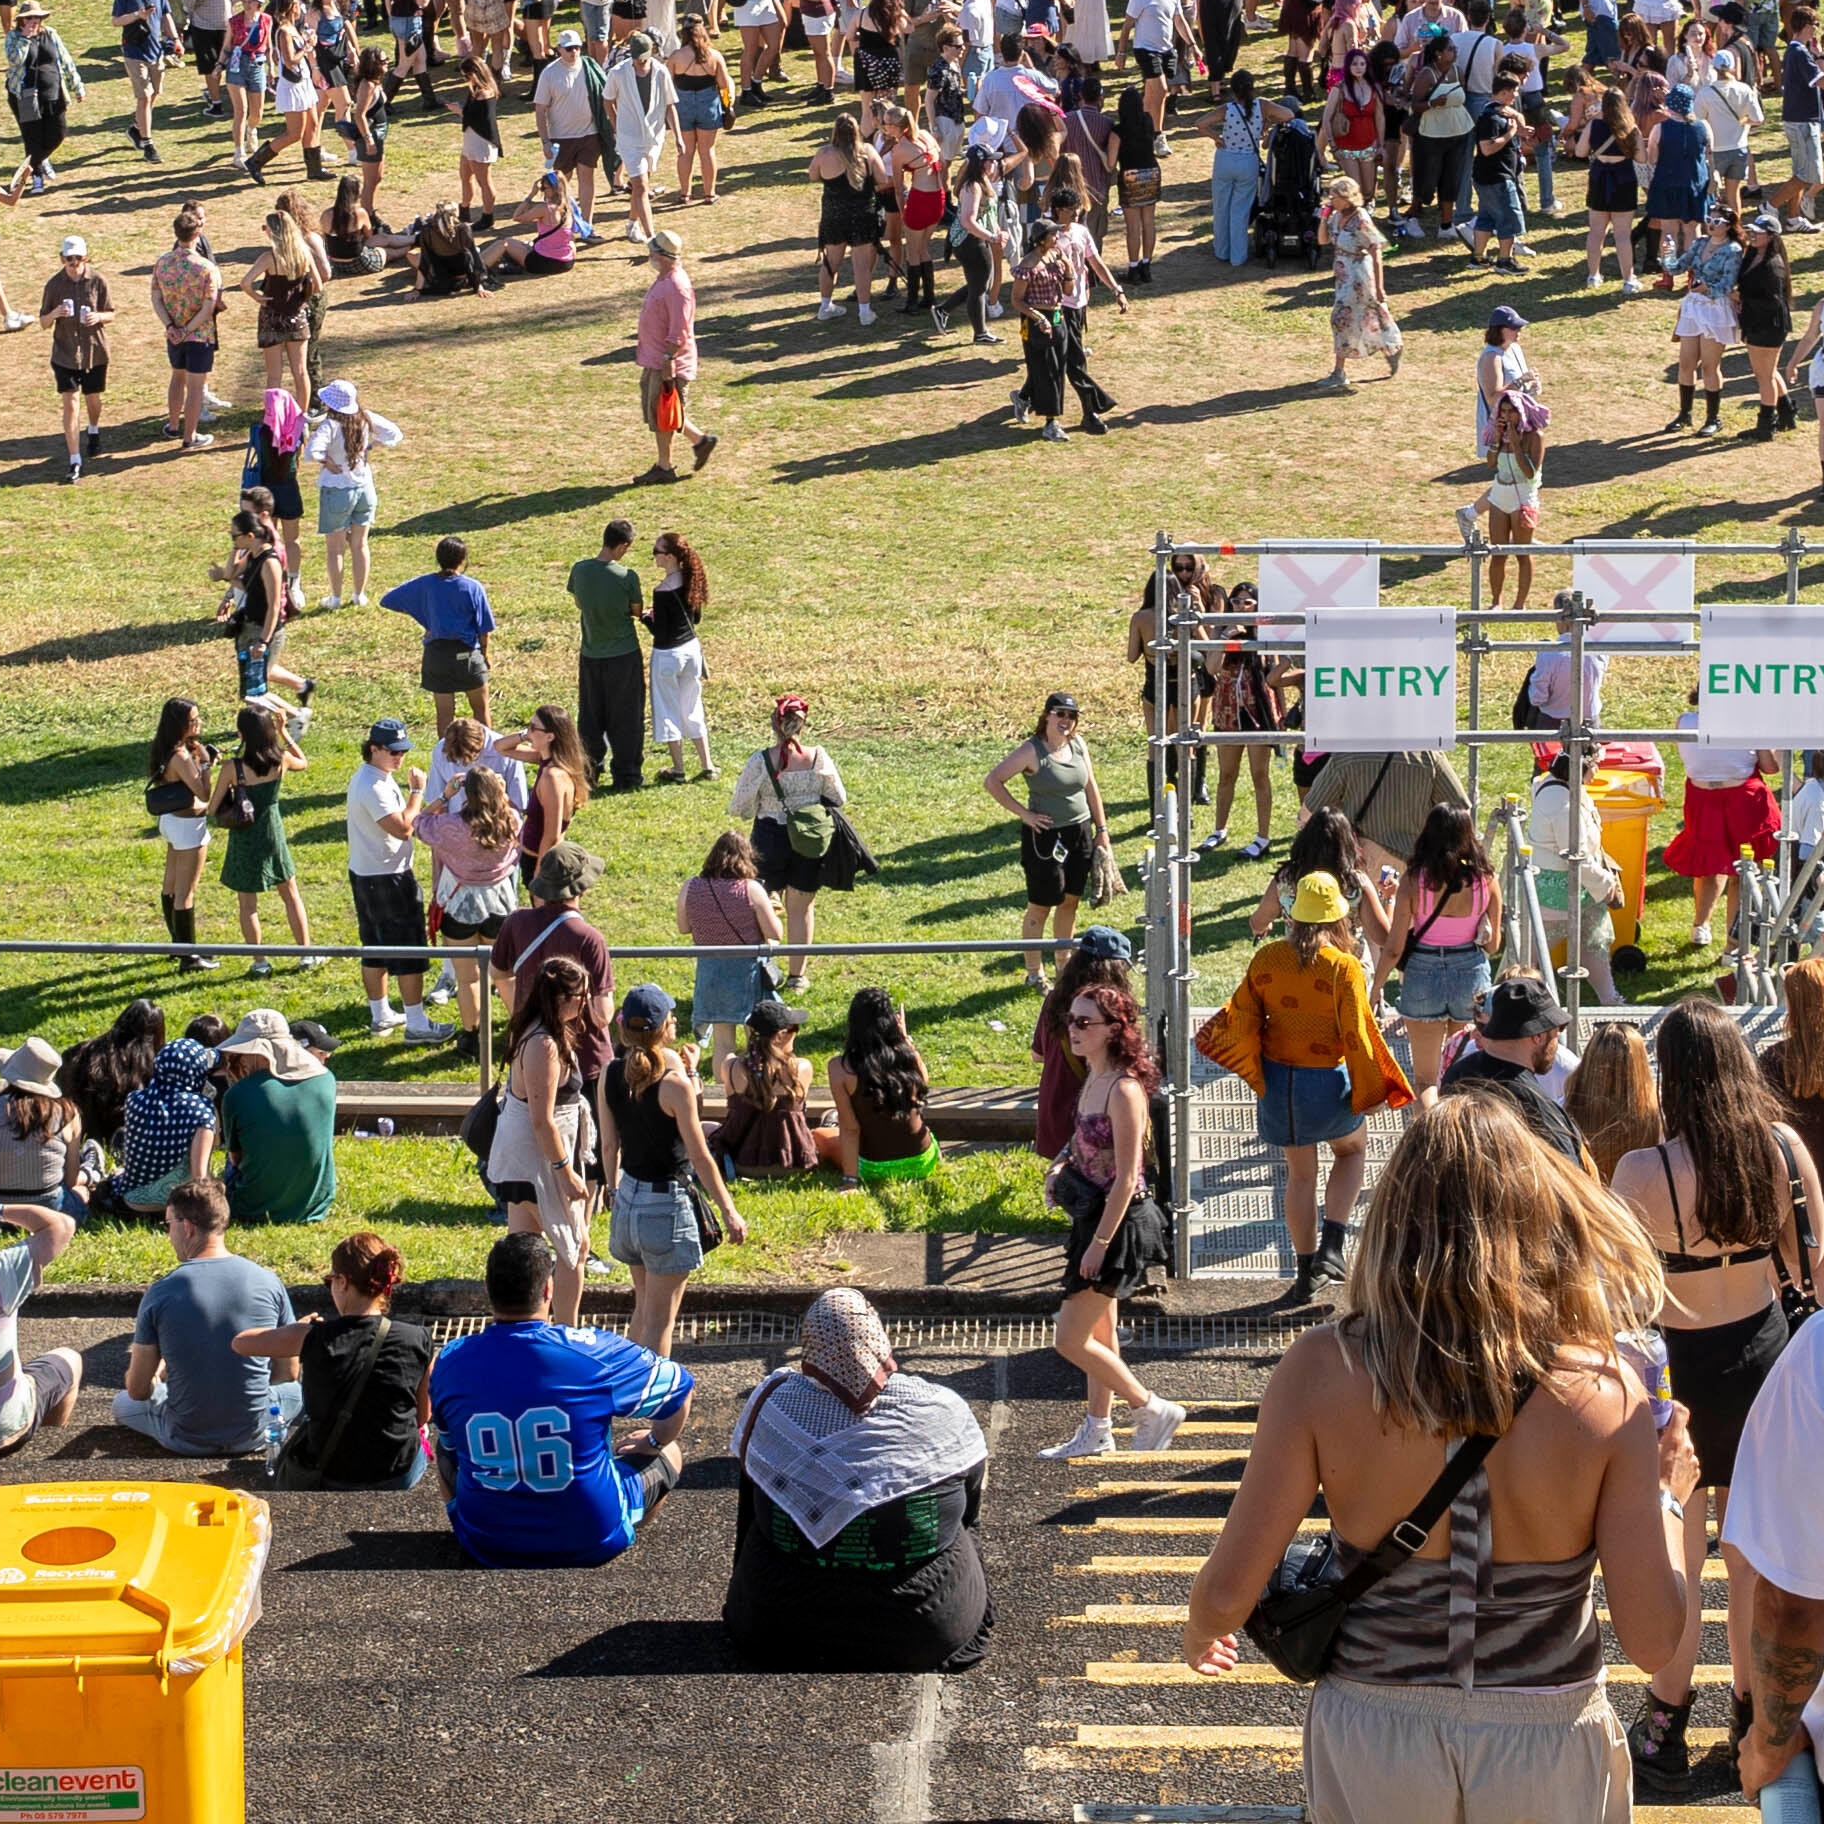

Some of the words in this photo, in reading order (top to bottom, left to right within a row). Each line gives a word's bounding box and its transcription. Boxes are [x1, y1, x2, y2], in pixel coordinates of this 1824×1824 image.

[1314, 664, 1450, 699] ENTRY
[465, 1406, 574, 1493] 96
[34, 1568, 117, 1578] Recycling
